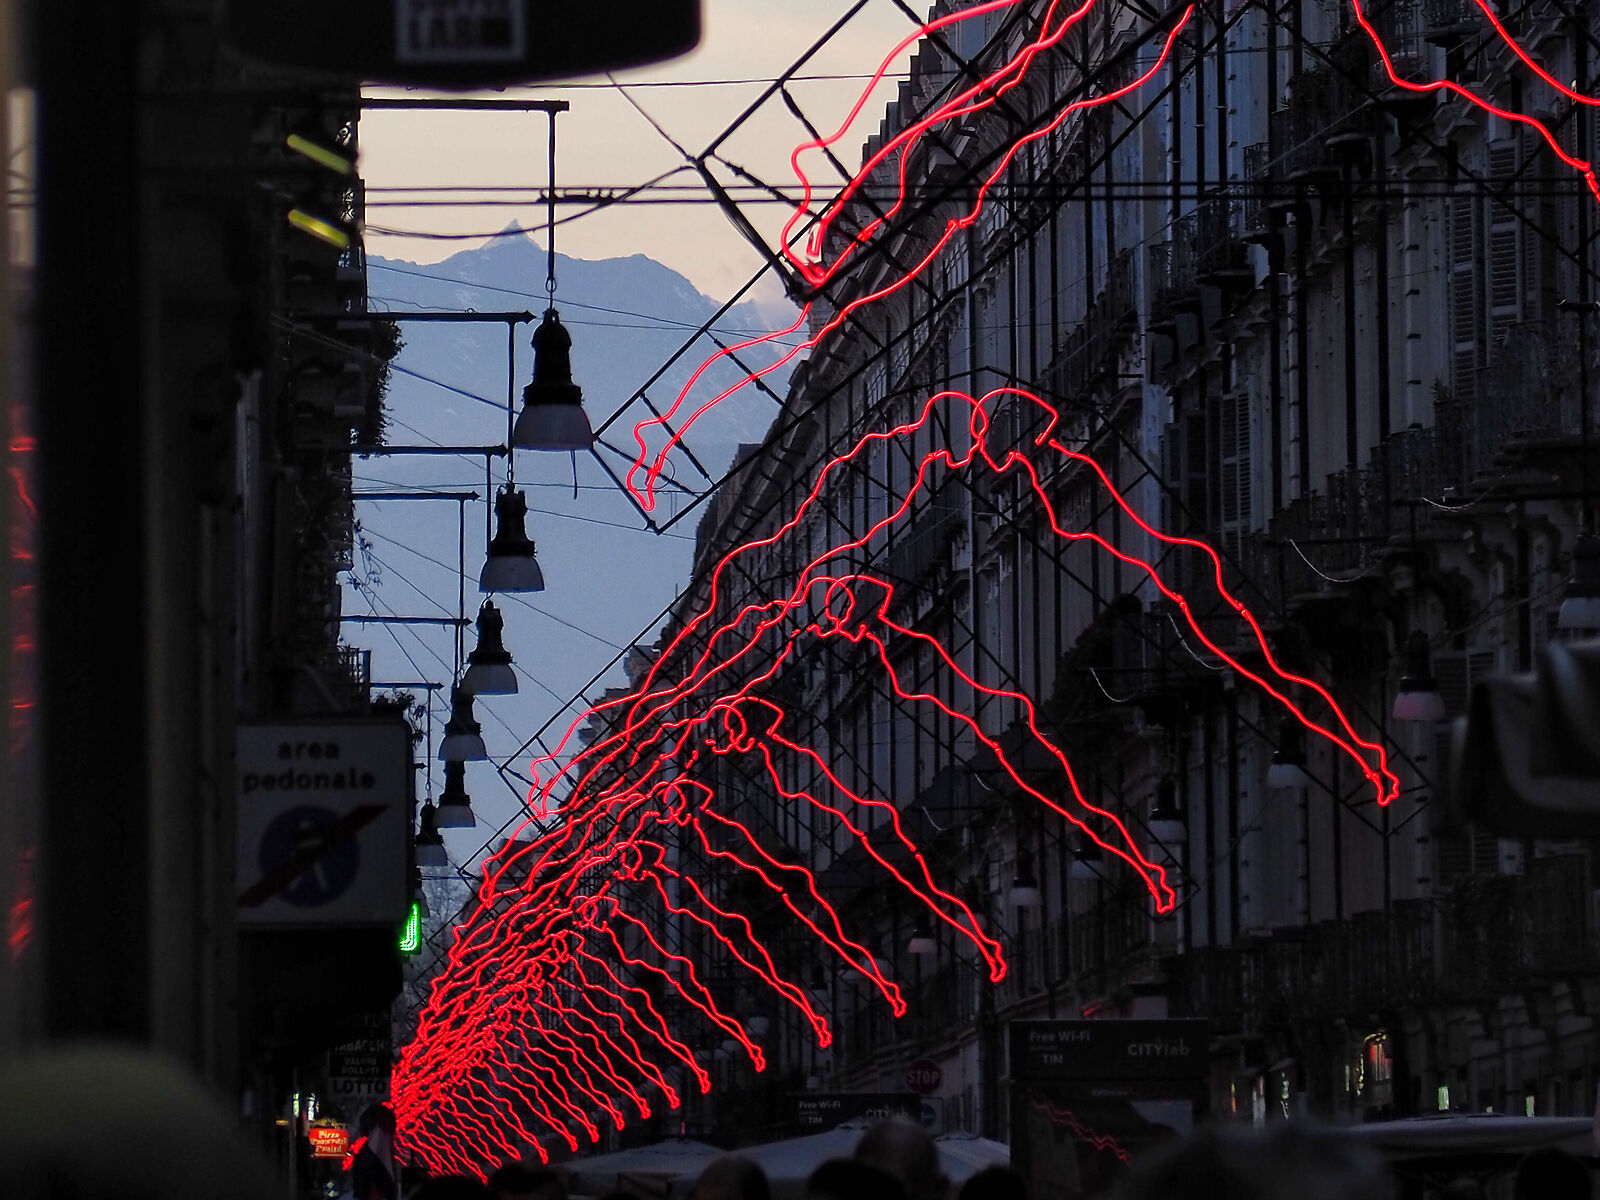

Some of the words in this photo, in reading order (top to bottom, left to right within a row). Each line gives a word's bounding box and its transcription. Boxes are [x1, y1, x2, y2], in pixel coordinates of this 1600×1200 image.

[277, 742, 339, 760] area
[243, 767, 376, 794] pedonale
[1029, 1031, 1056, 1042] Free
[1042, 1053, 1064, 1065] TIM
[907, 1070, 941, 1085] STOP
[333, 1079, 386, 1094] LOTTO
[798, 1100, 818, 1110] Free
[807, 1116, 823, 1125] TIM
